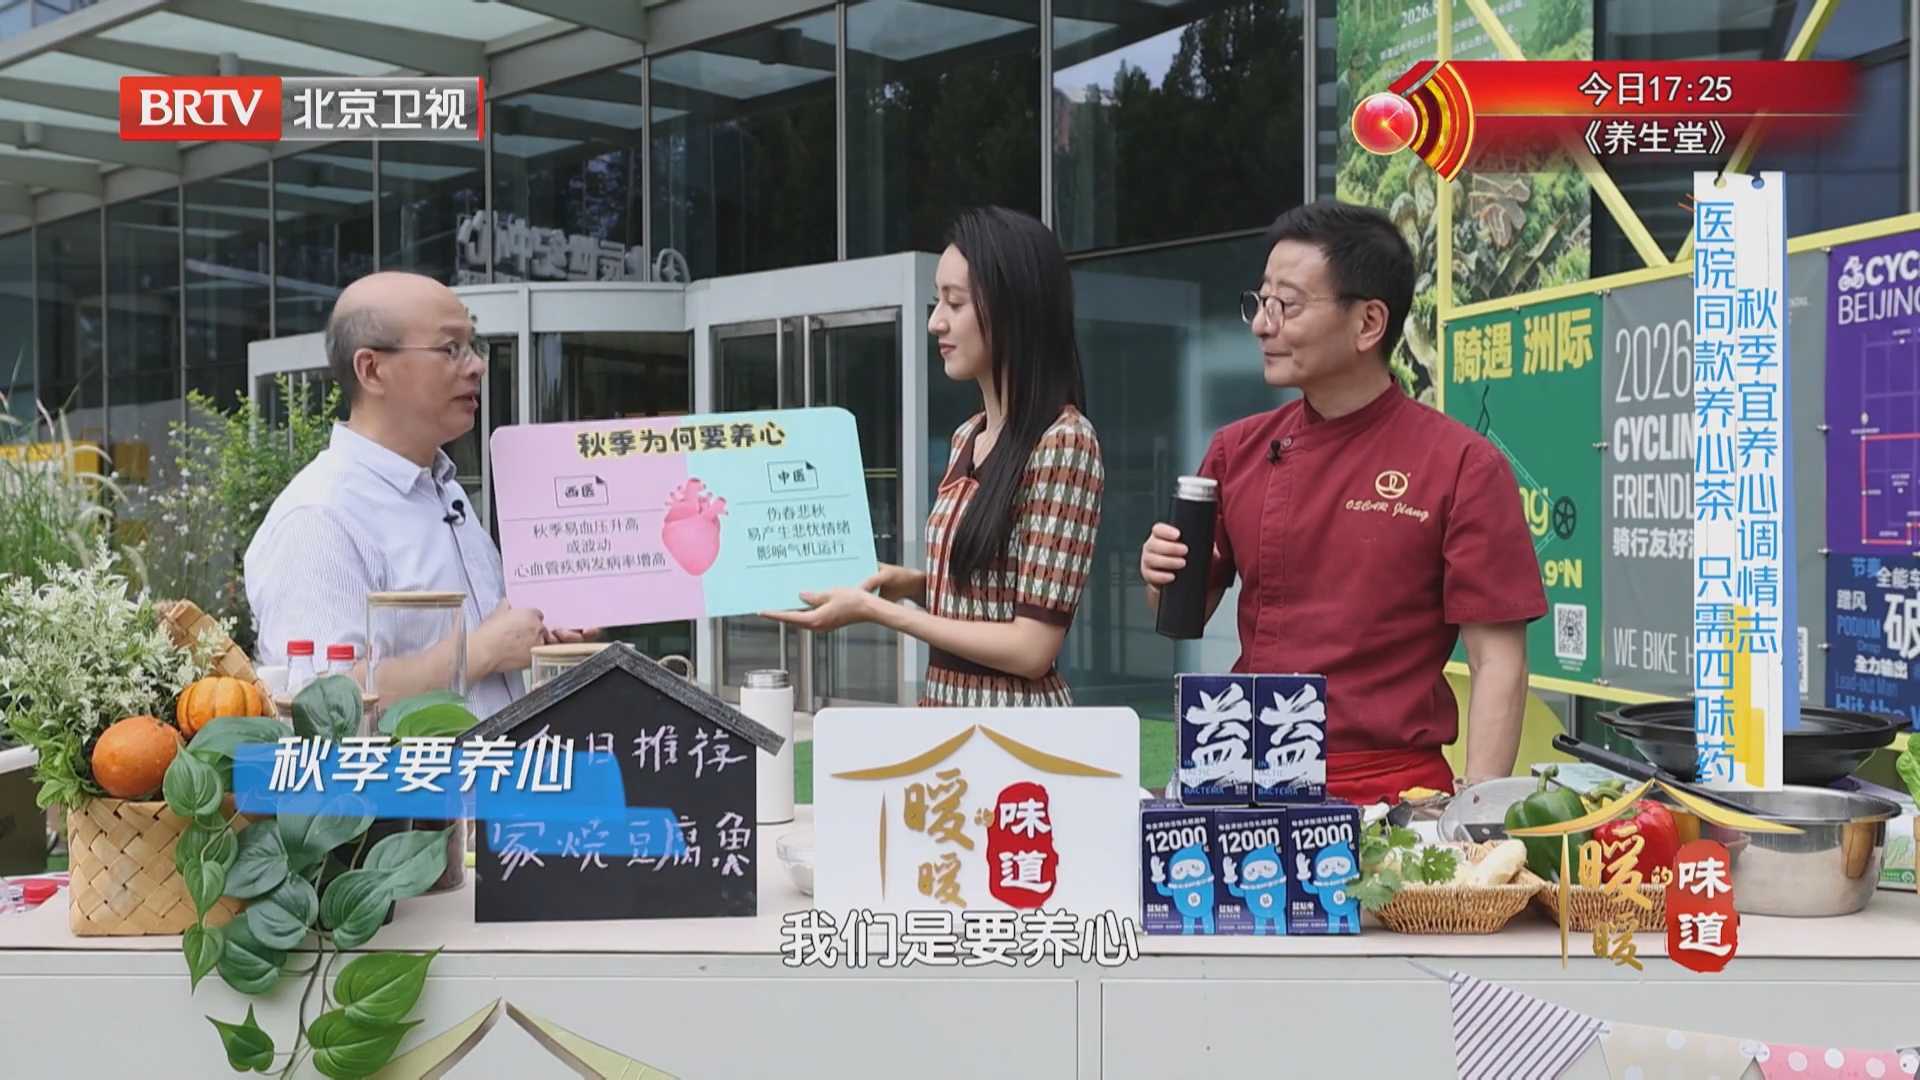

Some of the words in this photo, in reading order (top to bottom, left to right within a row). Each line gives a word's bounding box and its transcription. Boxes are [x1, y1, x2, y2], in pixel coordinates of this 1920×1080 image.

[1615, 319, 1692, 403] 2026
[577, 421, 786, 459] 秋季为何要养心
[777, 467, 806, 485] 中医
[767, 503, 827, 521] 伤春悲秋
[1345, 499, 1389, 513] OSCAR
[533, 517, 639, 539] 秋季易血压升高
[747, 519, 851, 541] 易产生悲忧情绪
[566, 537, 612, 555] 或波动
[757, 539, 845, 561] 影响气机运行
[514, 552, 666, 578] 心血管疾病发病率增高
[1613, 627, 1638, 668] WE
[1643, 630, 1678, 674] BIKE
[1854, 654, 1908, 680] 全力输出
[1145, 826, 1208, 854] 12000
[1218, 827, 1280, 855] 12000
[1291, 823, 1353, 851] 12000
